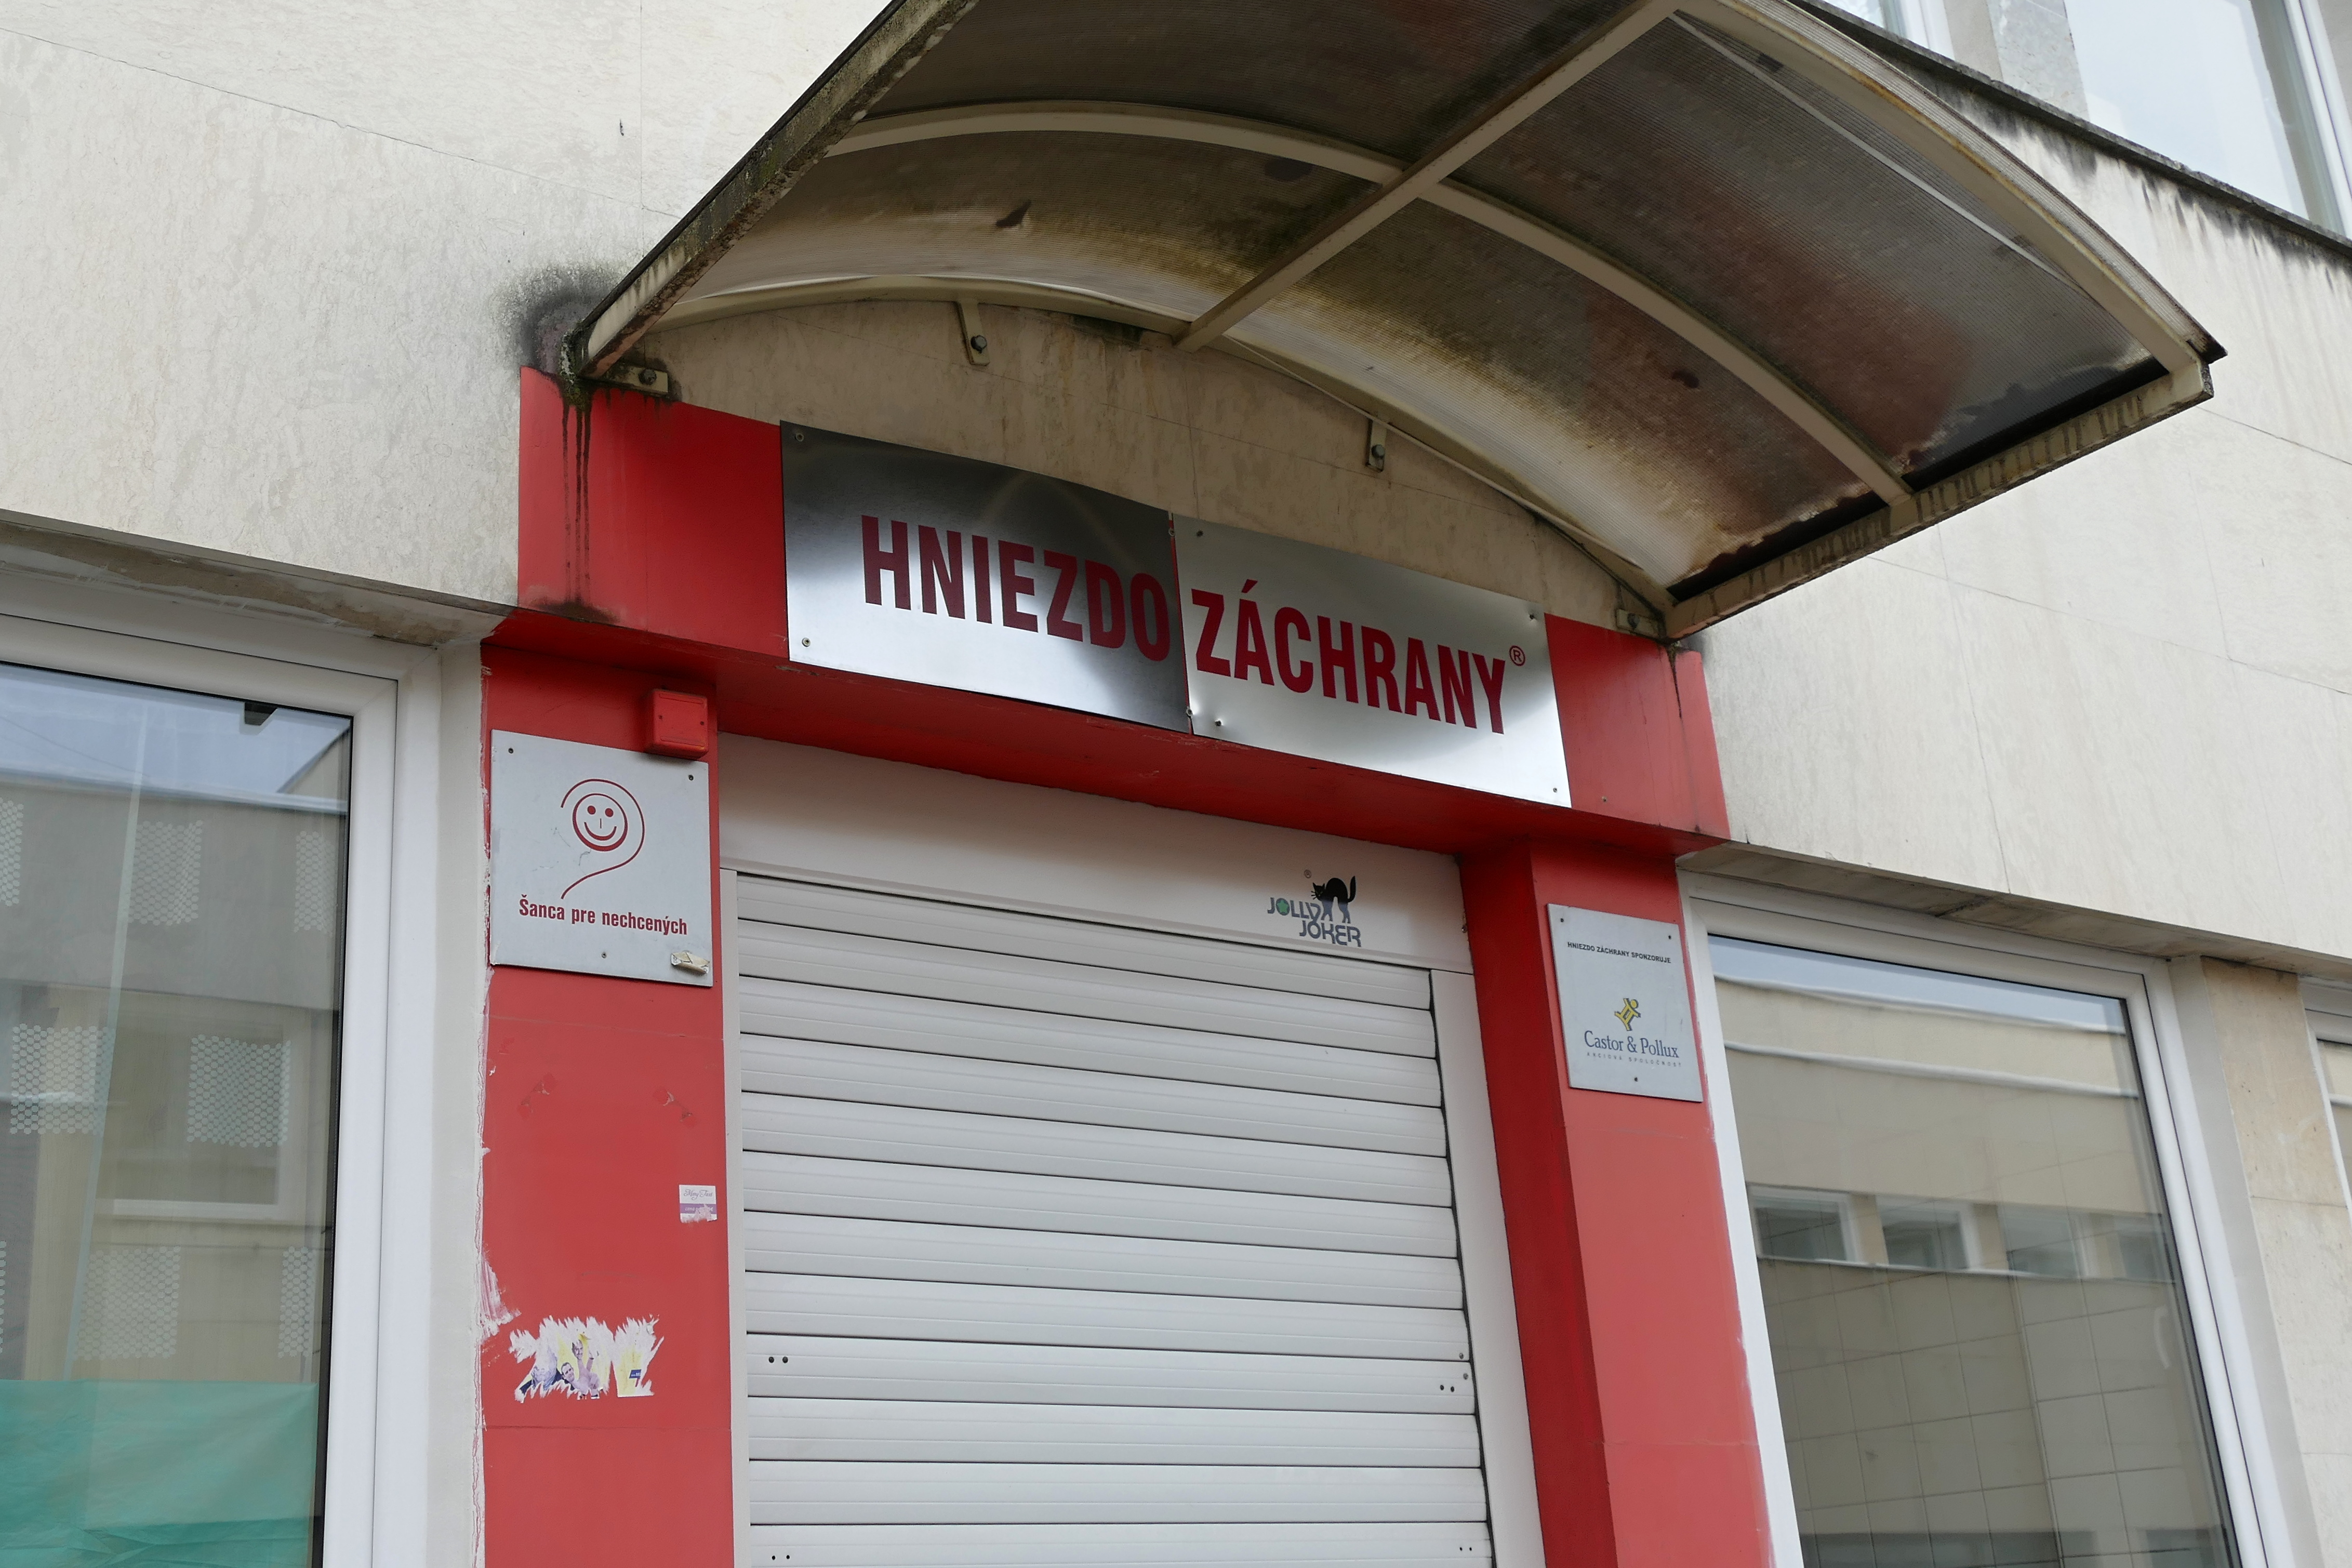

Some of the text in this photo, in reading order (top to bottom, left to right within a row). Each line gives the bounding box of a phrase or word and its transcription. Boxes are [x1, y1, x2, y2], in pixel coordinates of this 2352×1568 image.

[861, 515, 1171, 662] HNIEZDO
[519, 894, 687, 936] Šanca pre nechcených
[1267, 897, 1321, 922] JOLLY
[1299, 920, 1361, 947] JOKER
[1567, 941, 1671, 964] HNIEZDO ZÁCHRANY SPONZORUJE
[1584, 1030, 1680, 1058] Castor & Pollux
